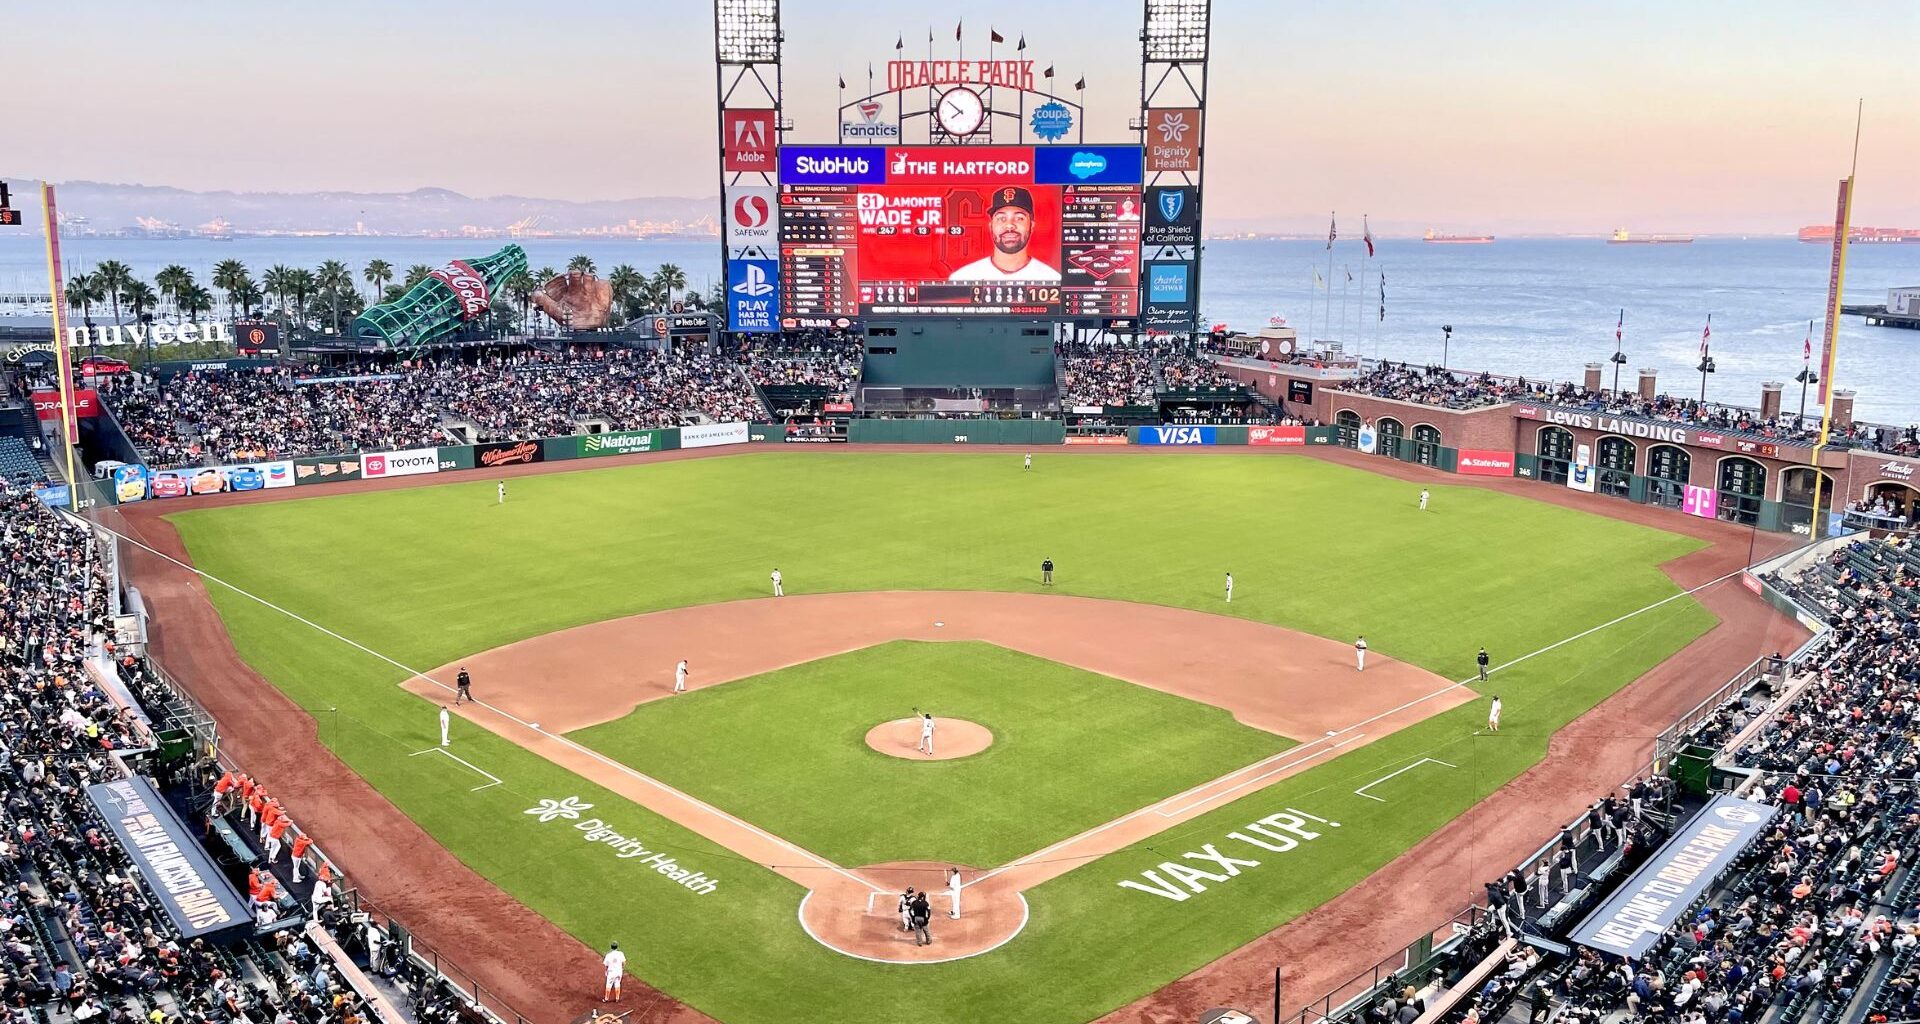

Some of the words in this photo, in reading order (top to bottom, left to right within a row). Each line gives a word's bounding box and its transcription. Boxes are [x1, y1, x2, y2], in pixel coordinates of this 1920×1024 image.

[887, 60, 970, 92] ORACLE
[978, 60, 1035, 93] PARK
[1037, 110, 1069, 121] coupa
[843, 123, 898, 136] Fanatics
[736, 151, 765, 162] Adobe
[1153, 146, 1191, 160] Dignity
[796, 156, 870, 174] StubHub
[906, 162, 936, 175] THE
[943, 162, 1030, 175] HARTFORD
[1155, 158, 1190, 169] Health
[862, 195, 878, 208] 31
[886, 197, 942, 208] LAMONTE
[858, 210, 912, 225] WADE
[916, 210, 940, 225] JR
[734, 228, 769, 237] SAFEWAY
[1149, 226, 1166, 234] Blue
[1168, 226, 1191, 234] Shield
[1146, 234, 1155, 242] of
[1156, 234, 1193, 242] California
[1153, 275, 1184, 285] charles
[909, 287, 915, 295] 0
[1029, 288, 1059, 301] 102
[738, 300, 769, 311] PLAY
[1167, 309, 1189, 319] your
[67, 322, 225, 347] nuveen
[35, 399, 90, 411] ORALE
[1154, 427, 1202, 444] VISA
[1597, 416, 1686, 443] LANDING
[601, 433, 652, 448] National
[630, 445, 650, 453] Rental
[1761, 445, 1773, 455] 89
[390, 456, 435, 469] TOYOTA
[481, 448, 517, 465] Welcome
[1472, 458, 1491, 467] State
[1492, 460, 1510, 468] Farm
[439, 461, 456, 469] 354
[1880, 461, 1914, 475] Alaska
[1792, 524, 1810, 535] 309
[130, 825, 172, 848] SAN
[573, 818, 651, 859] Dignity
[640, 853, 719, 895] Health
[1117, 843, 1261, 901] VAX
[1226, 807, 1341, 852] UP!
[141, 841, 206, 894] FRANCISCO
[1592, 886, 1672, 948] WELCOME
[1656, 840, 1714, 885] ORACLE
[1696, 823, 1740, 852] PARK
[173, 887, 231, 929] GIANTS
